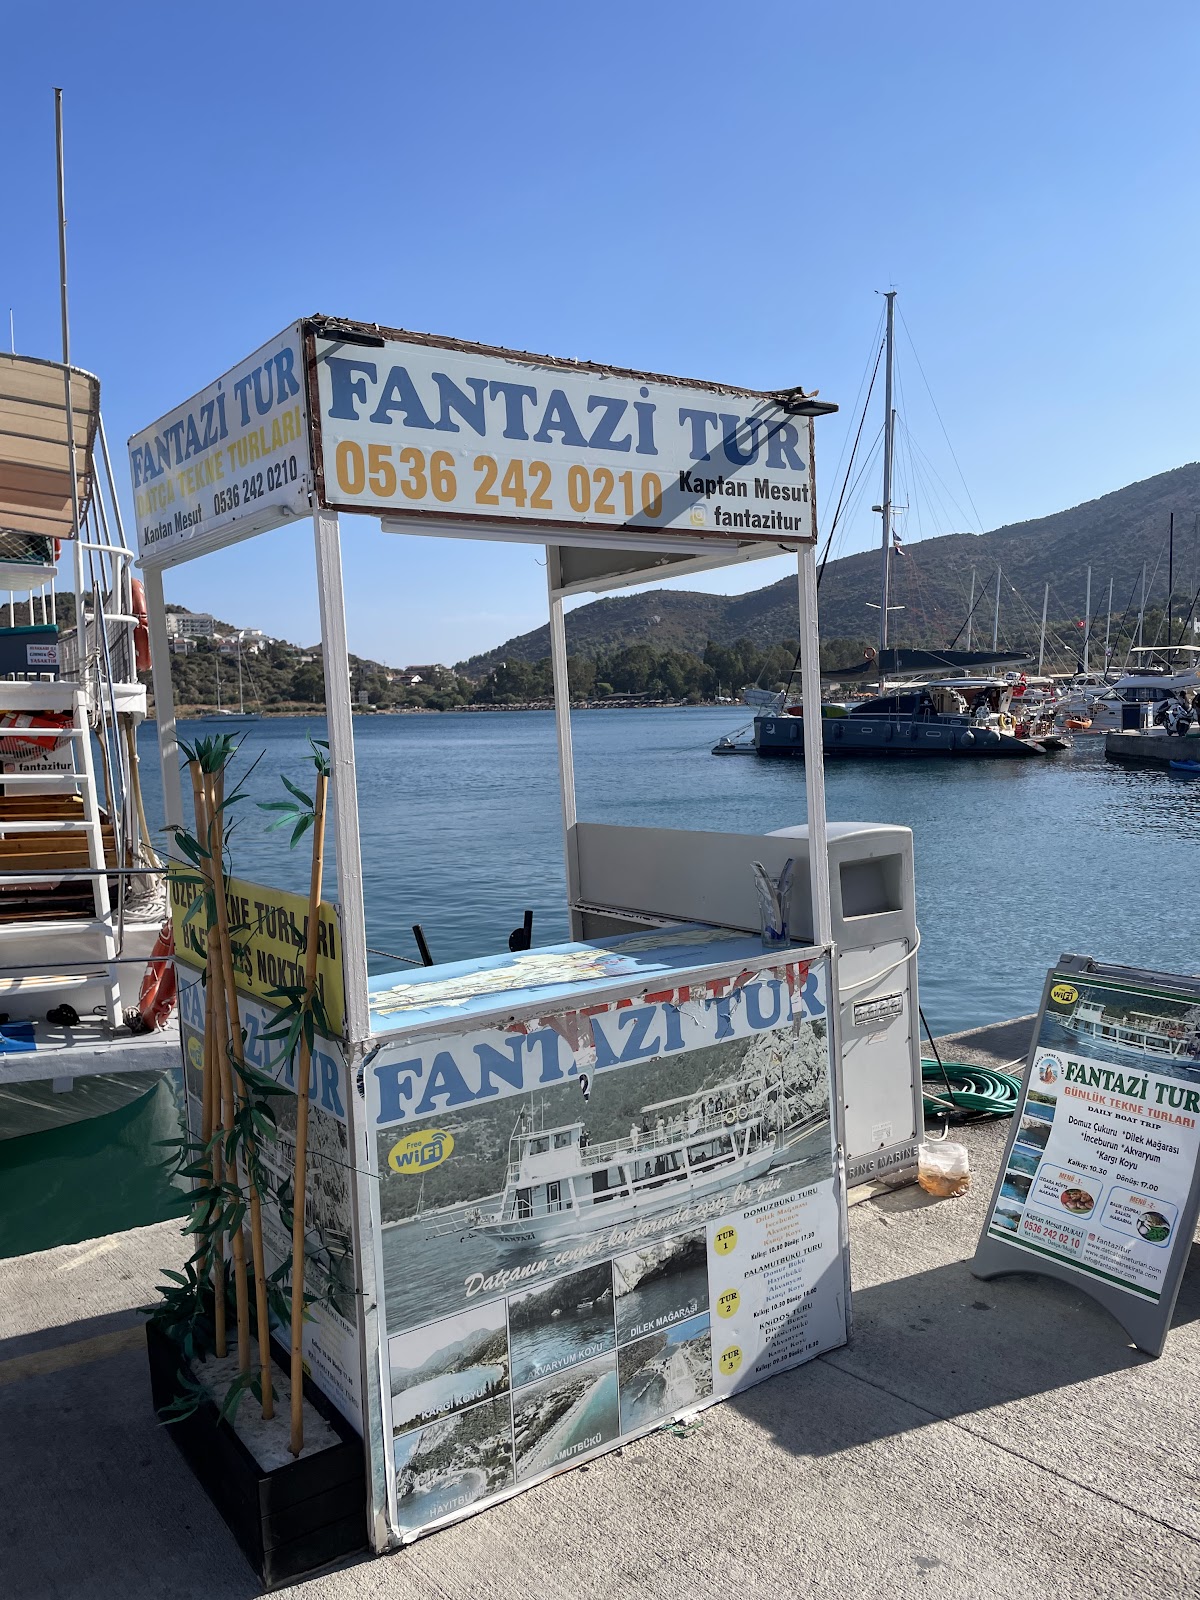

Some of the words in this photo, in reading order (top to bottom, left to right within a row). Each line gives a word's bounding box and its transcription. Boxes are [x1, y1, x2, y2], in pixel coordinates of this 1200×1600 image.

[131, 381, 228, 488] FANTAZİ
[235, 347, 299, 427] TUR
[324, 356, 658, 456] FANTAZİ
[679, 408, 806, 471] TUR
[136, 479, 176, 518] DATÇA
[177, 451, 224, 497] TEKNE
[227, 405, 302, 472] TURLARI
[335, 440, 457, 503] 0536
[473, 455, 553, 510] 242
[567, 464, 663, 519] 0210
[679, 470, 748, 499] Kaptan
[754, 477, 809, 502] Mesut
[144, 522, 172, 546] Kaptan
[174, 503, 202, 533] Mesut
[214, 484, 240, 515] 0536
[243, 472, 264, 504] 242
[267, 455, 297, 492] 0210
[714, 506, 801, 531] fantazitur
[19, 762, 72, 771] fantazitur
[257, 949, 324, 1006] NOKTI
[705, 973, 825, 1039] TUR
[181, 978, 273, 1074] FAZİ
[1065, 1061, 1149, 1100] FANTAZİ
[1154, 1082, 1200, 1114] TUR
[1064, 1086, 1107, 1105] GÜNLÜK
[1109, 1097, 1143, 1114] TEKNE
[1147, 1107, 1196, 1128] TURLARI
[1088, 1105, 1113, 1117] DAILY
[1115, 1113, 1138, 1124] BOAT
[1139, 1119, 1162, 1131] TRIP
[406, 1141, 422, 1150] Free
[1068, 1115, 1092, 1129] Domuz
[1093, 1121, 1118, 1137] Çukuru
[1145, 1136, 1180, 1155] Mağarası
[877, 1145, 918, 1169] MARINE
[1119, 1156, 1138, 1171] Koyu
[1058, 1172, 1075, 1182] MENÜ
[1116, 1173, 1140, 1186] Dönüş:
[1140, 1181, 1159, 1192] 17.00
[798, 1187, 818, 1199] TURU
[1130, 1195, 1147, 1206] MENÜ
[553, 1239, 606, 1266] cennet
[757, 1176, 782, 1202] gün
[716, 1229, 734, 1241] TUR
[723, 1242, 728, 1250] 1
[1024, 1220, 1042, 1234] 0536
[1043, 1227, 1058, 1240] 242
[1058, 1233, 1069, 1244] 02
[1071, 1237, 1080, 1249] 10
[1097, 1235, 1132, 1254] fantazitur
[803, 1243, 823, 1255] TURU
[719, 1292, 738, 1305] TUR
[726, 1305, 731, 1313] 2
[792, 1302, 813, 1315] TURU
[630, 1320, 655, 1337] DİLEK
[528, 1354, 577, 1380] AKVARYUM
[578, 1342, 603, 1358] KOYU
[721, 1349, 739, 1361] TUR
[421, 1401, 454, 1420] KARGI
[455, 1388, 485, 1406] KOYU
